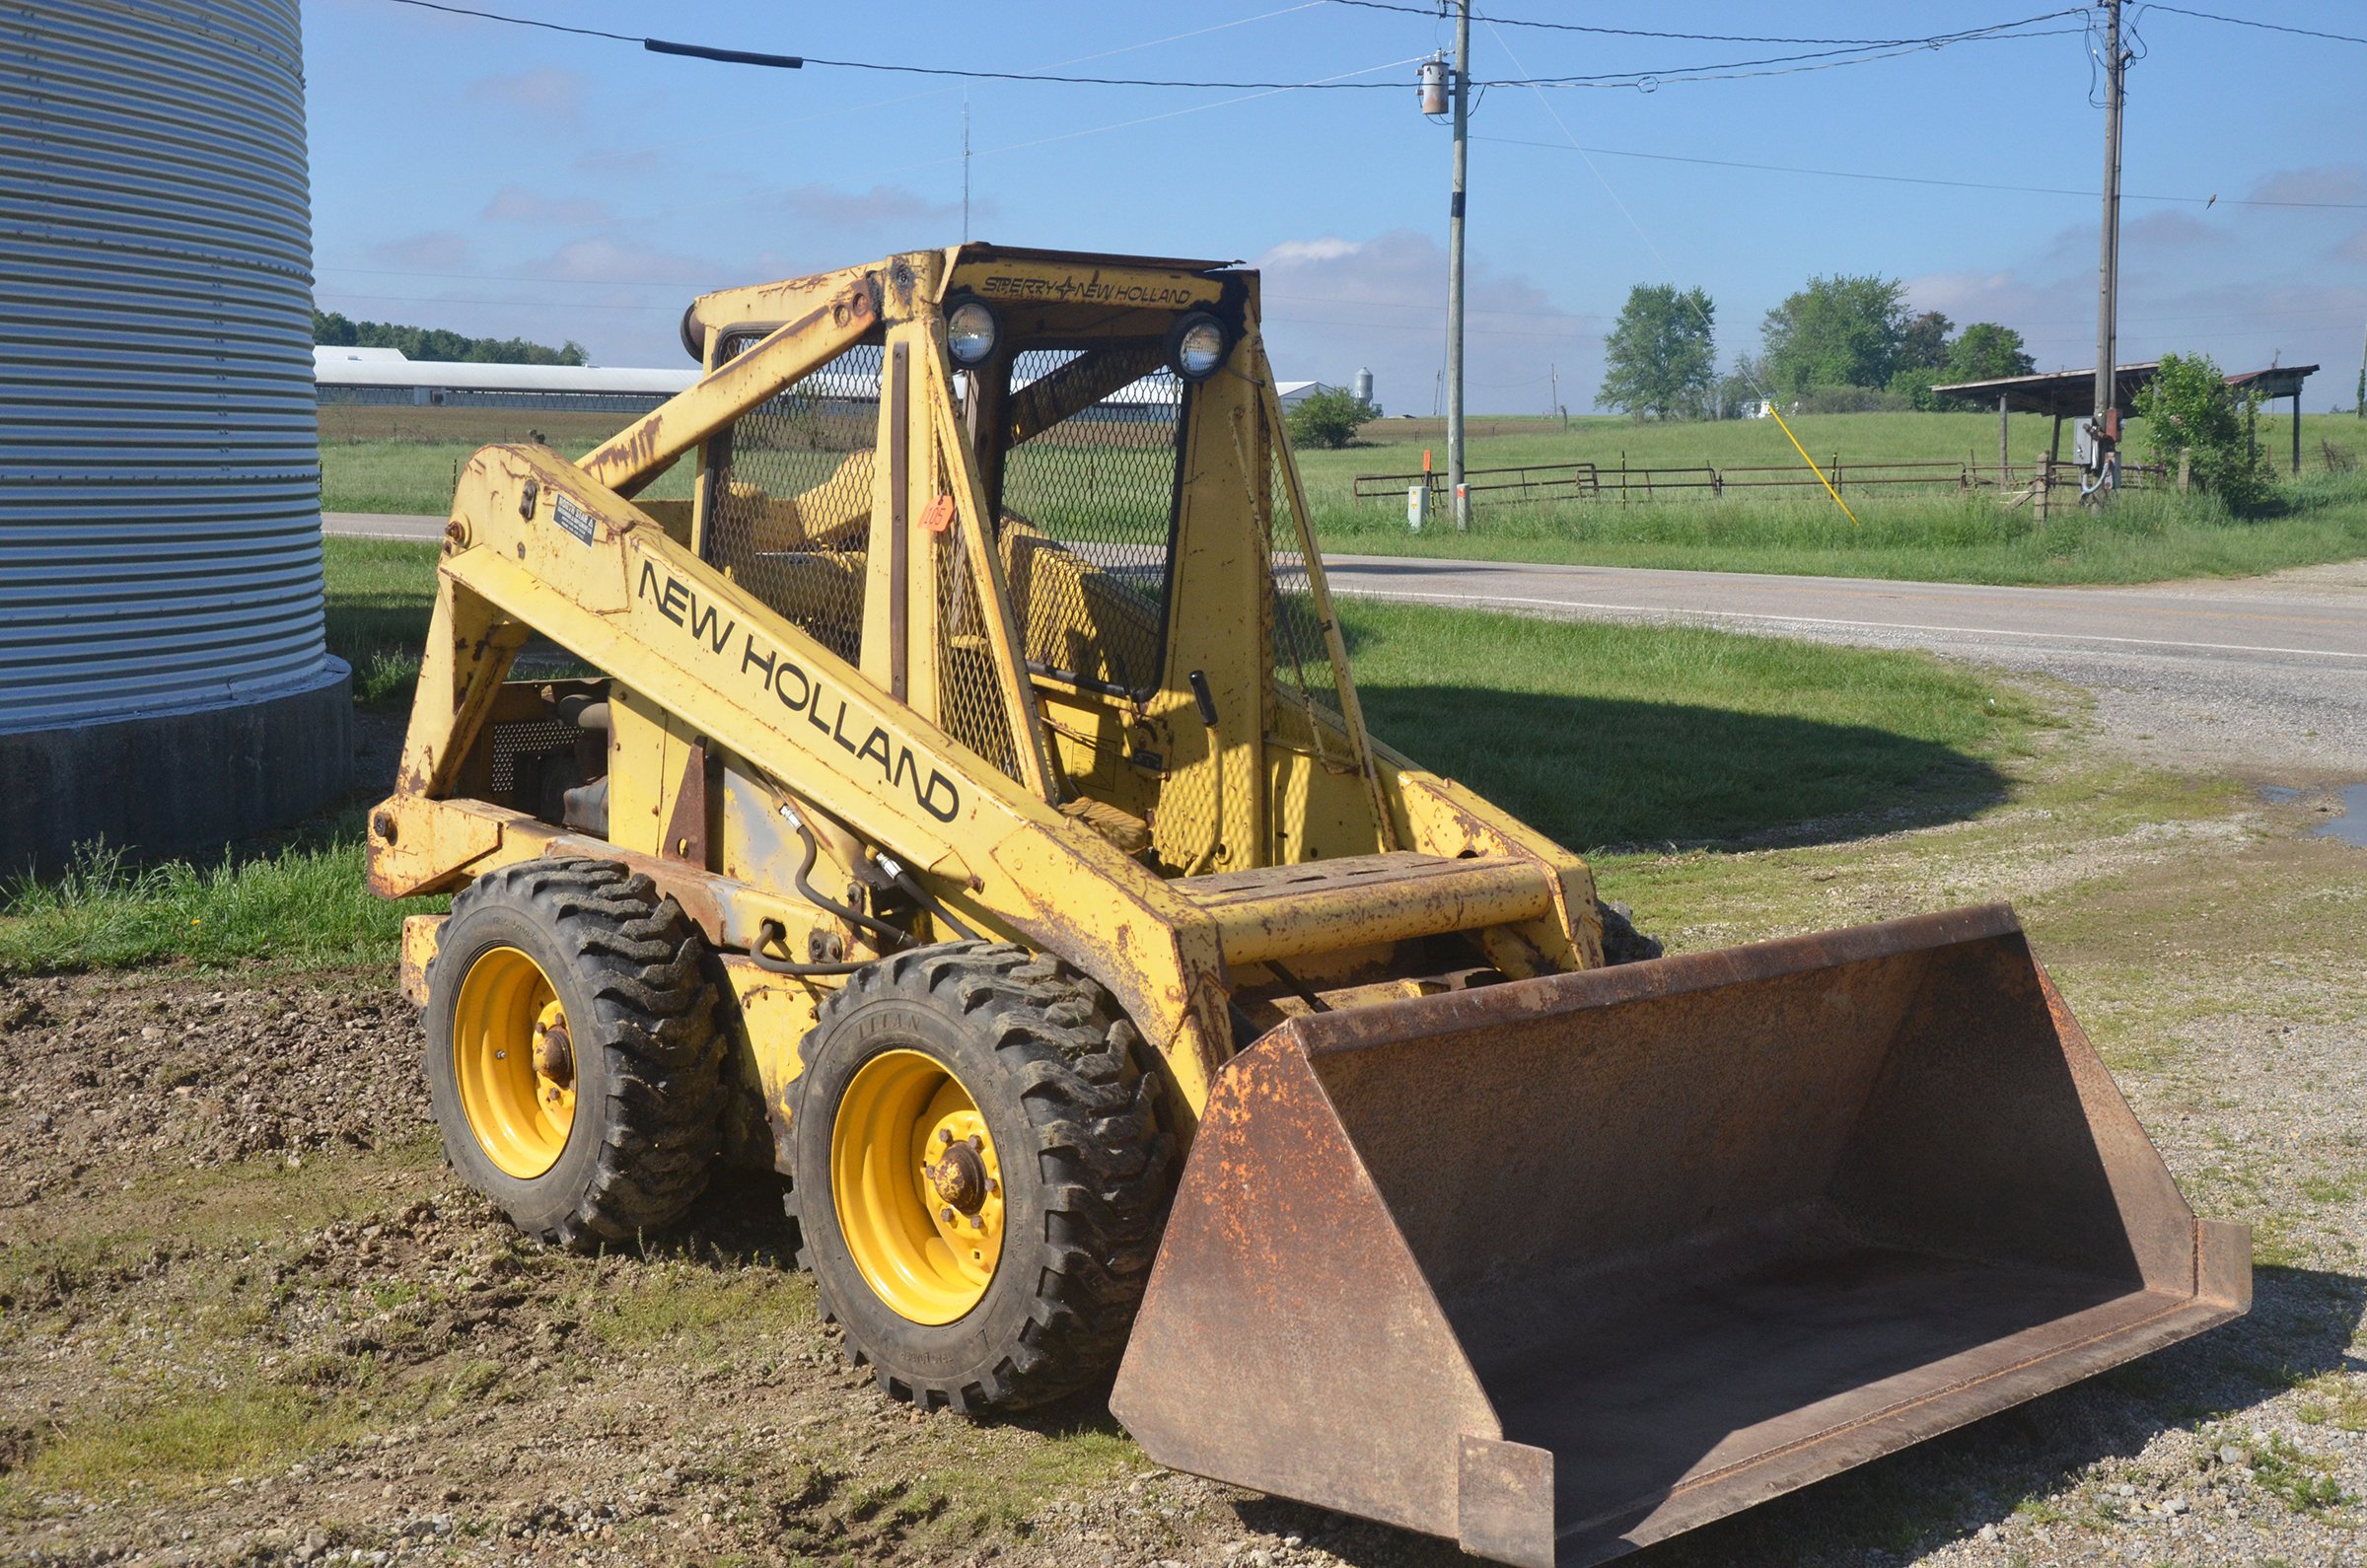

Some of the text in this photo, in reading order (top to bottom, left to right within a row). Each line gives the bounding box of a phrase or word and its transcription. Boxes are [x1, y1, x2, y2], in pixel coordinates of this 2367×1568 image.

[982, 277, 1191, 304] SPERRY NEW HOLLAND
[924, 507, 945, 525] 105
[638, 560, 960, 823] NEW HOLLAND
